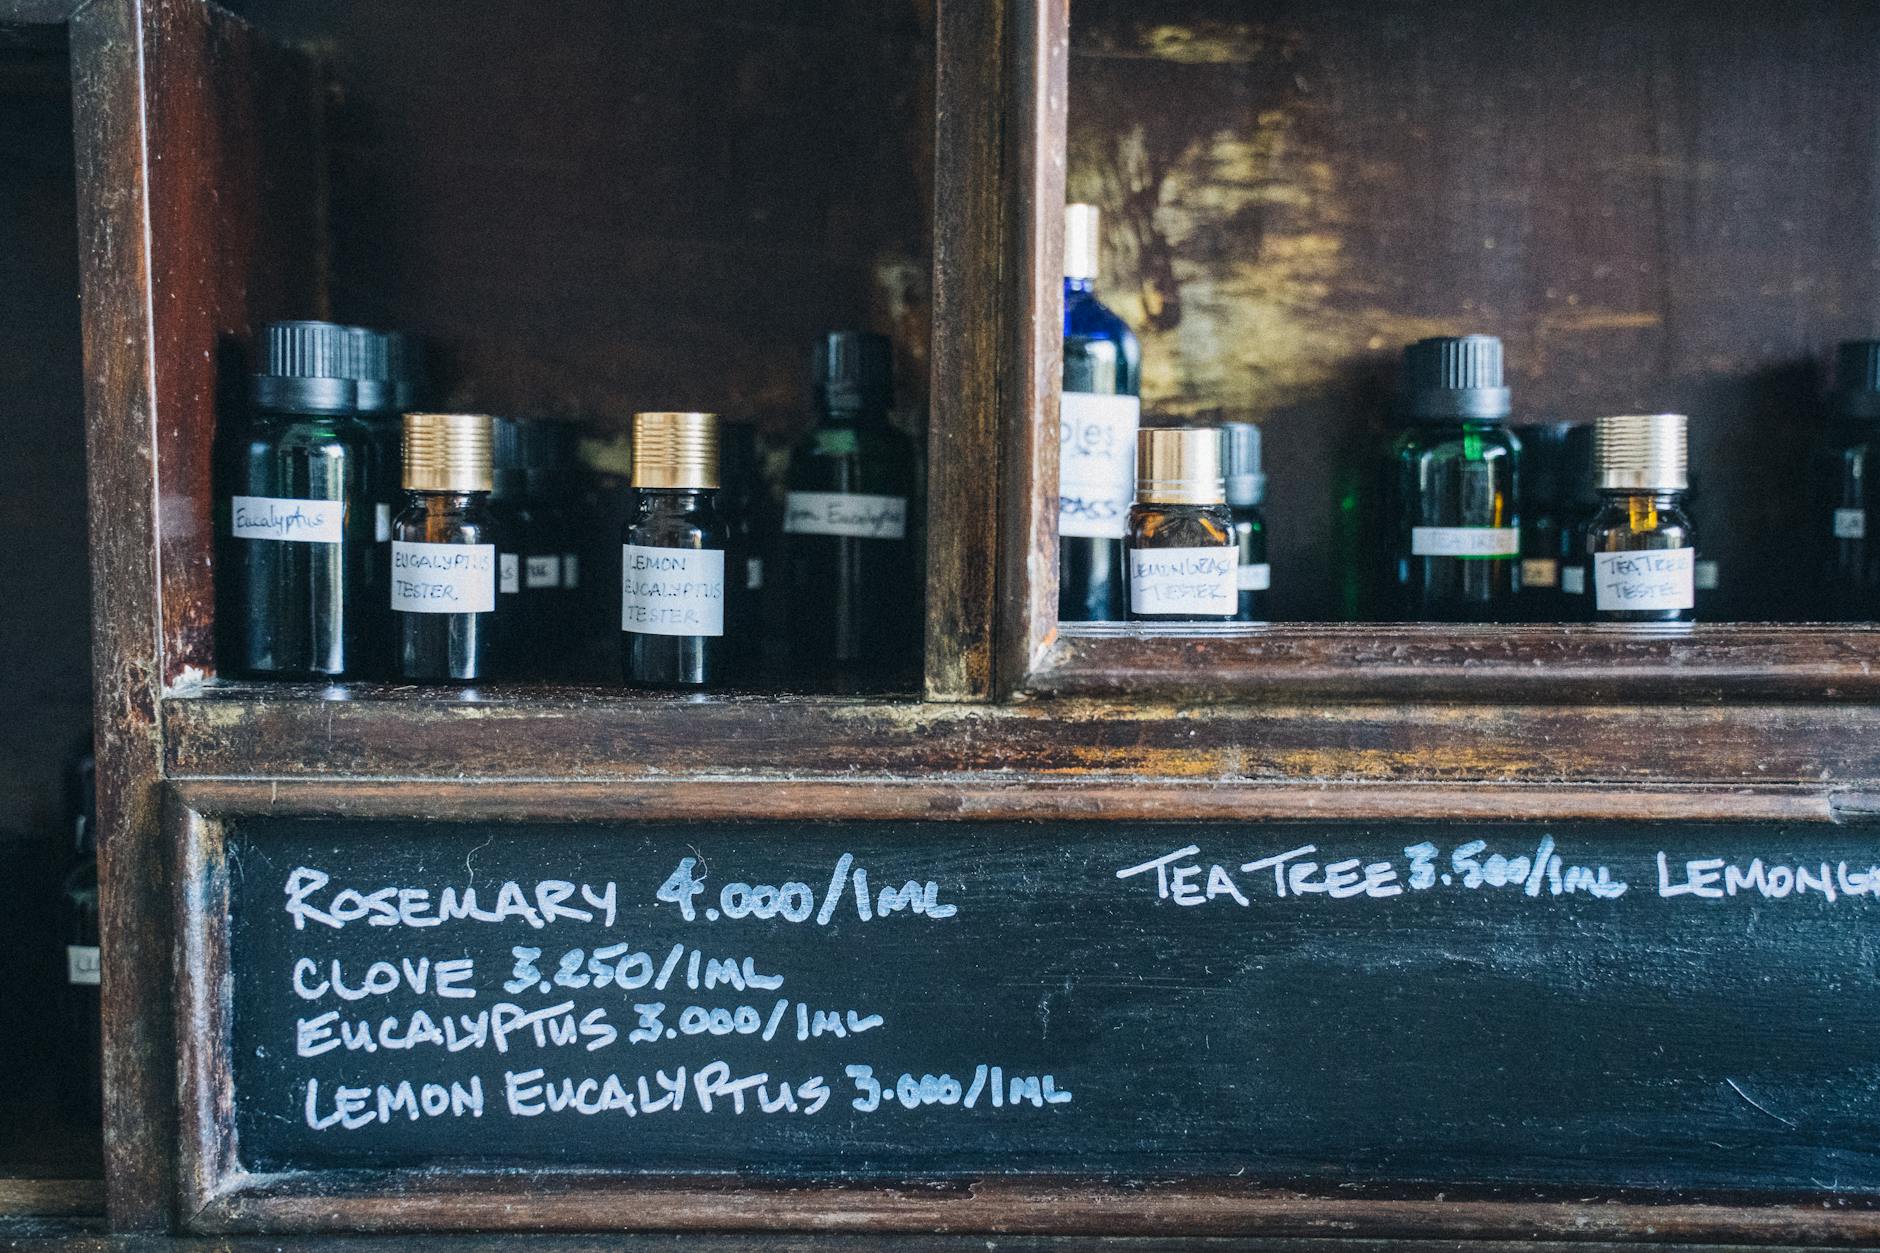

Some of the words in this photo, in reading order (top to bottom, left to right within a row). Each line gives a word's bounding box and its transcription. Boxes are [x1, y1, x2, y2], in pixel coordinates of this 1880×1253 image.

[236, 504, 325, 536] Eucalyptus
[395, 551, 489, 571] EUCALYPTUS
[630, 554, 686, 571] LEMON
[397, 580, 458, 600] TESTER
[625, 578, 721, 600] EUCALYPTUS
[1140, 582, 1227, 601] TESTER
[628, 605, 699, 624] TESTER
[1116, 844, 1249, 906] TEA
[1241, 844, 1403, 898] TREE
[285, 866, 617, 930] ROSEMARY
[292, 957, 477, 1000] CLOVE
[297, 1000, 617, 1057] EUCALYPTUS
[305, 1075, 484, 1130] LEMON
[505, 1060, 831, 1117] EUCALYPTUS
